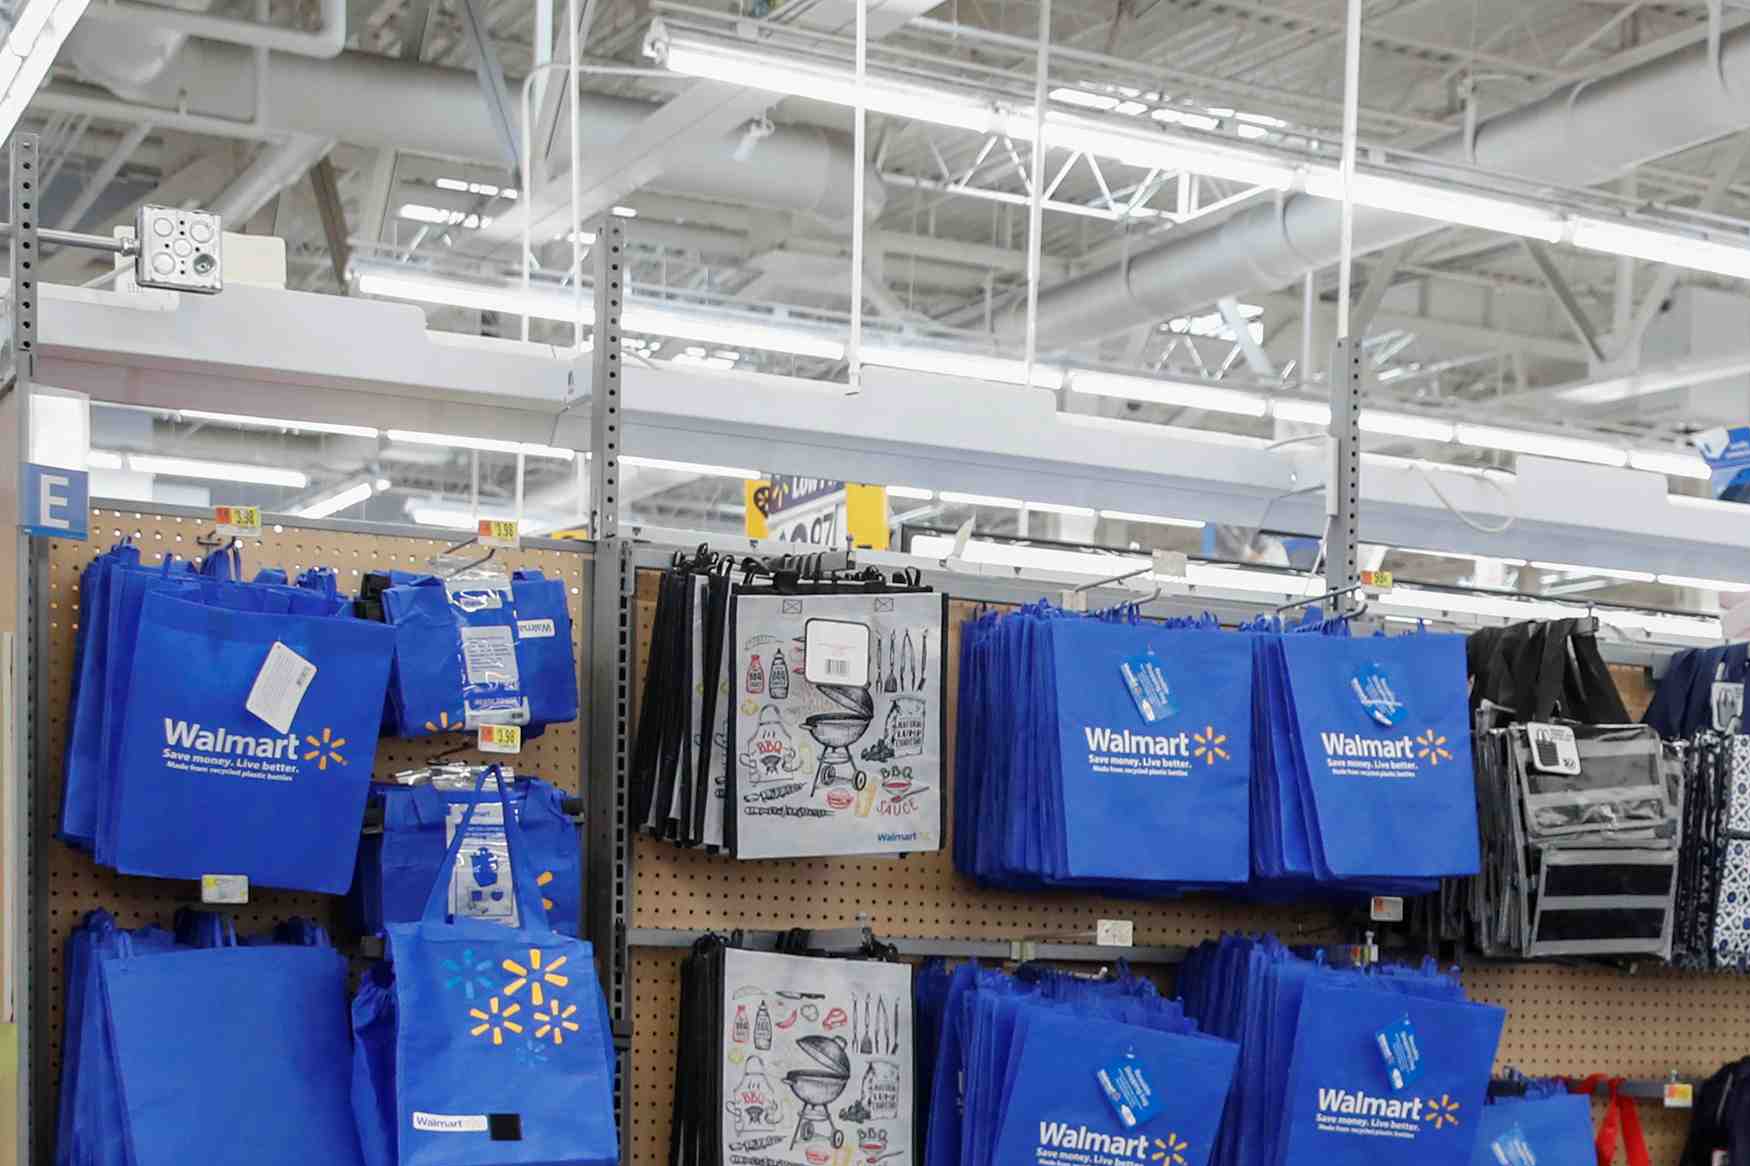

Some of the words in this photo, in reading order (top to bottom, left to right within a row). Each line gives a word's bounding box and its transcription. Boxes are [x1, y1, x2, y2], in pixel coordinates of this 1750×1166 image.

[40, 473, 70, 529] E
[164, 717, 300, 761] Walmart
[1085, 726, 1190, 757] Walmart
[1321, 731, 1415, 759] Walmart
[162, 748, 191, 762] Save
[192, 755, 234, 770] money.
[236, 758, 260, 770] Live
[262, 761, 300, 775] better.
[1089, 754, 1109, 765] Save
[1110, 756, 1142, 768] money.
[1143, 757, 1161, 768] Live
[1162, 759, 1192, 770] better.
[878, 832, 917, 842] Walmart
[1318, 1087, 1423, 1120] Walmart
[416, 1116, 463, 1128] Walmart
[1316, 1113, 1337, 1124] Save
[1371, 1118, 1390, 1128] Live
[1039, 1121, 1149, 1159] Walmart
[1036, 1147, 1058, 1159] Save
[1059, 1151, 1093, 1165] money.
[1094, 1155, 1113, 1166] Live
